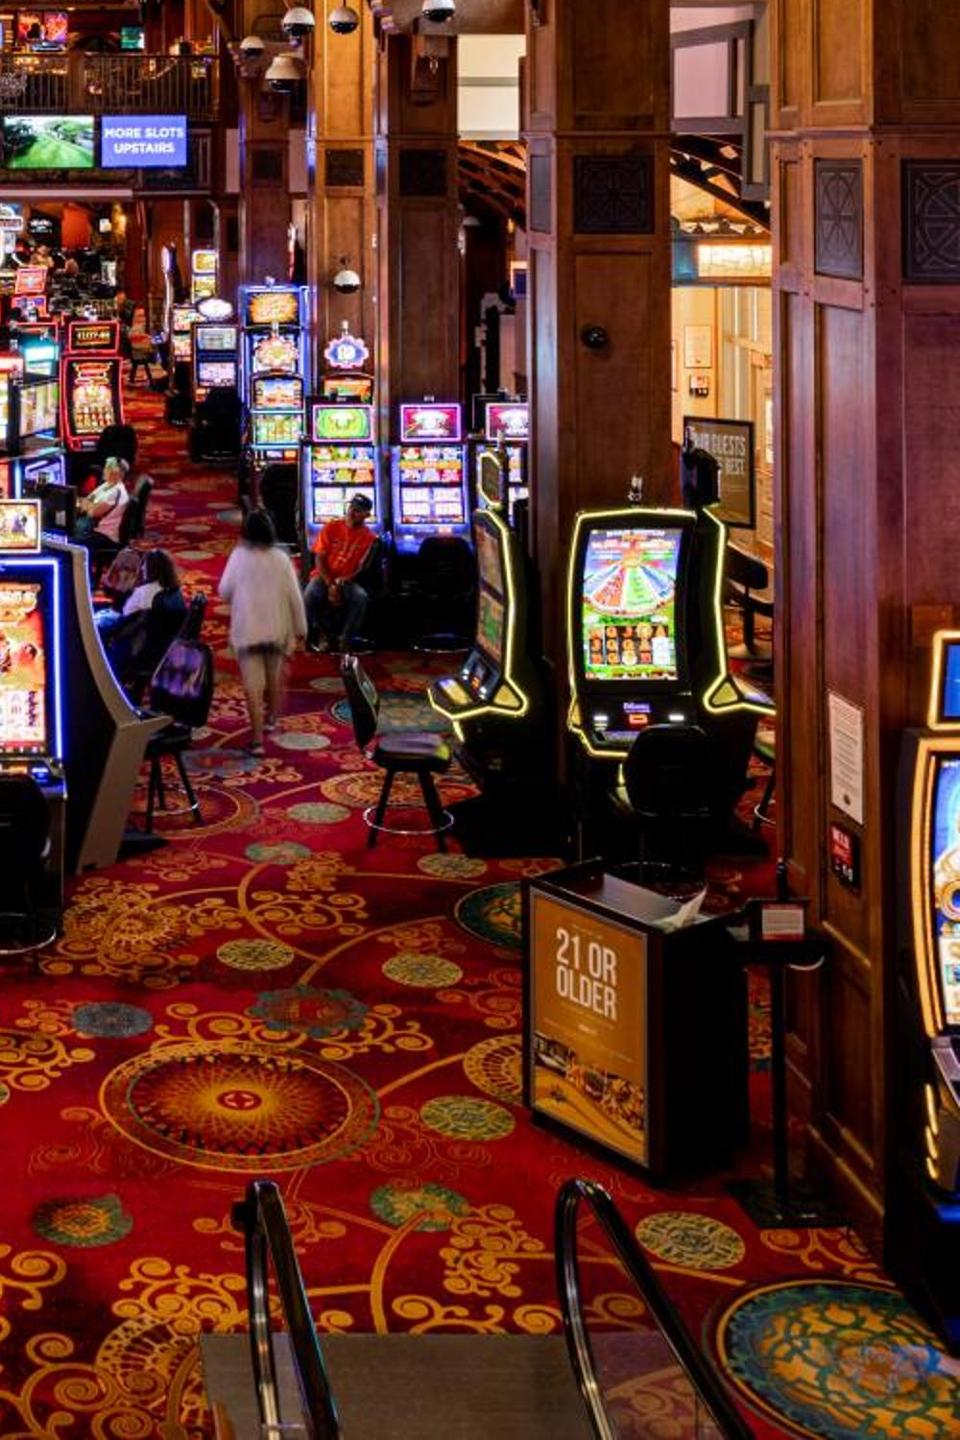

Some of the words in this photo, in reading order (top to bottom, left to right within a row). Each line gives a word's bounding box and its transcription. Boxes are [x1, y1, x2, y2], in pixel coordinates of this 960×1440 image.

[104, 128, 141, 138] MORE
[144, 128, 184, 138] SLOTS
[114, 143, 175, 154] UPSTAIRS
[556, 927, 580, 970] 21
[588, 941, 617, 987] OR
[556, 963, 617, 1021] OLDER
